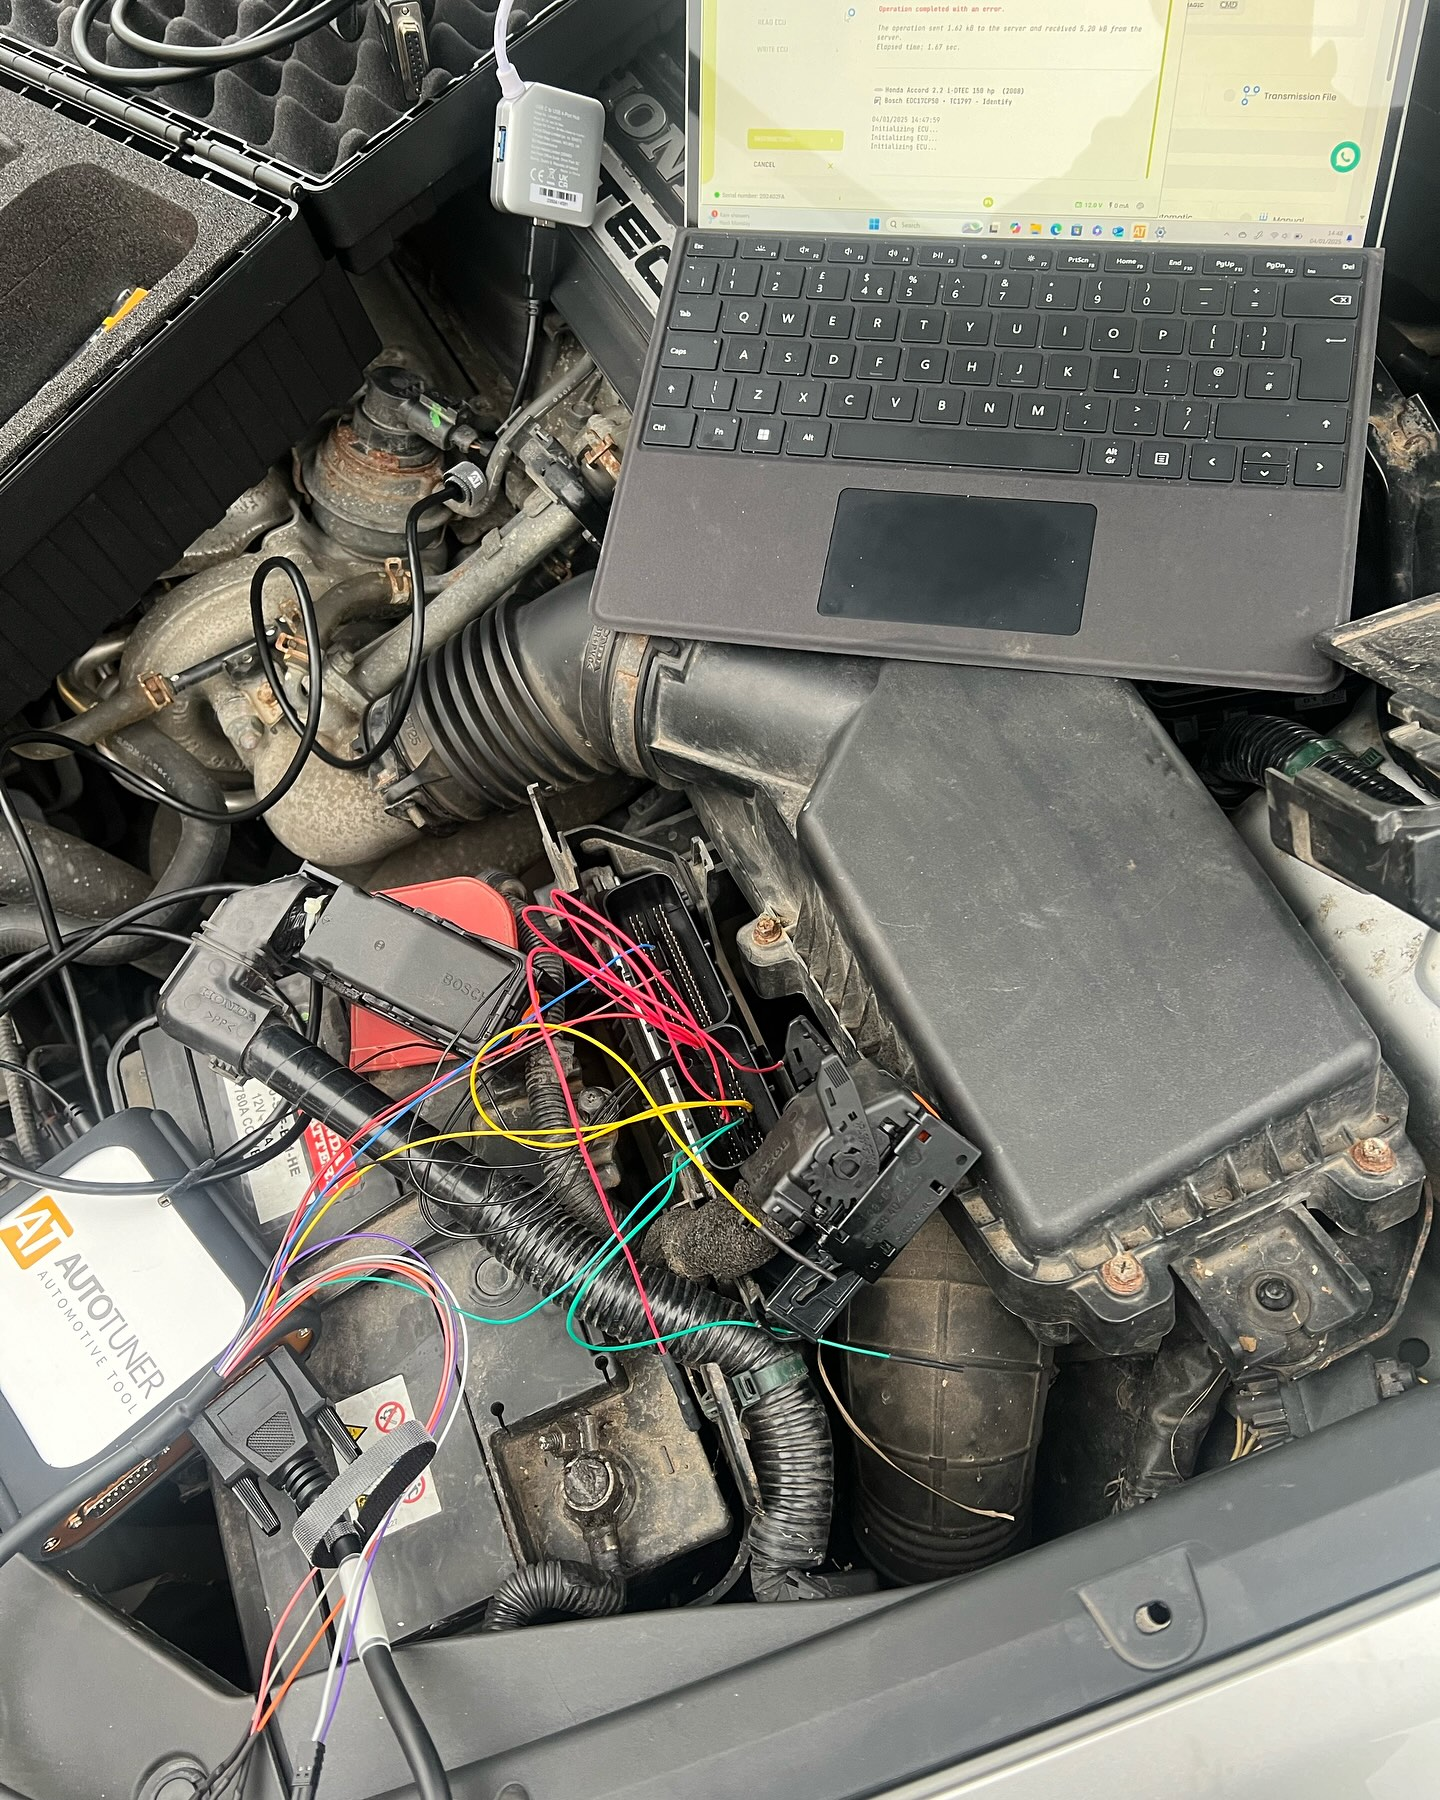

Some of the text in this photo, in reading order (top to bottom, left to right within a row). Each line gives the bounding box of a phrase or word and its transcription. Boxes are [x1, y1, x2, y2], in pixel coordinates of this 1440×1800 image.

[1264, 92, 1337, 101] Transmission File
[983, 98, 1012, 106] Identify
[872, 125, 914, 133] Initializing
[871, 134, 913, 142] Initializing
[871, 143, 913, 151] Initializing
[906, 288, 912, 296] 5
[952, 290, 958, 298] 6
[1000, 292, 1005, 300] 7
[1046, 294, 1052, 302] 8
[1095, 295, 1101, 303] 9
[1143, 297, 1150, 305] 0
[739, 312, 749, 323] Q
[783, 314, 794, 323] W
[829, 316, 836, 325] E
[874, 318, 881, 327] R
[921, 320, 928, 329] T
[967, 322, 974, 331] Y
[1013, 324, 1021, 333] U
[1063, 327, 1066, 336] I
[1109, 329, 1119, 338] O
[1159, 330, 1167, 339] P
[739, 350, 748, 359] A
[785, 353, 792, 362] S
[829, 355, 838, 364] D
[876, 357, 883, 366] F
[921, 360, 930, 369] G
[968, 362, 976, 371] H
[1017, 365, 1022, 374] J
[1064, 367, 1072, 376] K
[1114, 369, 1120, 378] L
[754, 390, 763, 399] Z
[799, 393, 808, 402] X
[845, 395, 854, 405] C
[892, 398, 900, 407] V
[938, 401, 945, 410] B
[985, 403, 994, 413] N
[1032, 405, 1044, 415] M
[200, 986, 258, 1023] HONDA
[232, 1087, 252, 1116] 780A
[250, 1092, 266, 1114] 12V
[14, 1207, 70, 1258] AT
[54, 1253, 165, 1399] AUTOTUNER
[37, 1271, 137, 1414] AUTOMOTIVE TOOL
